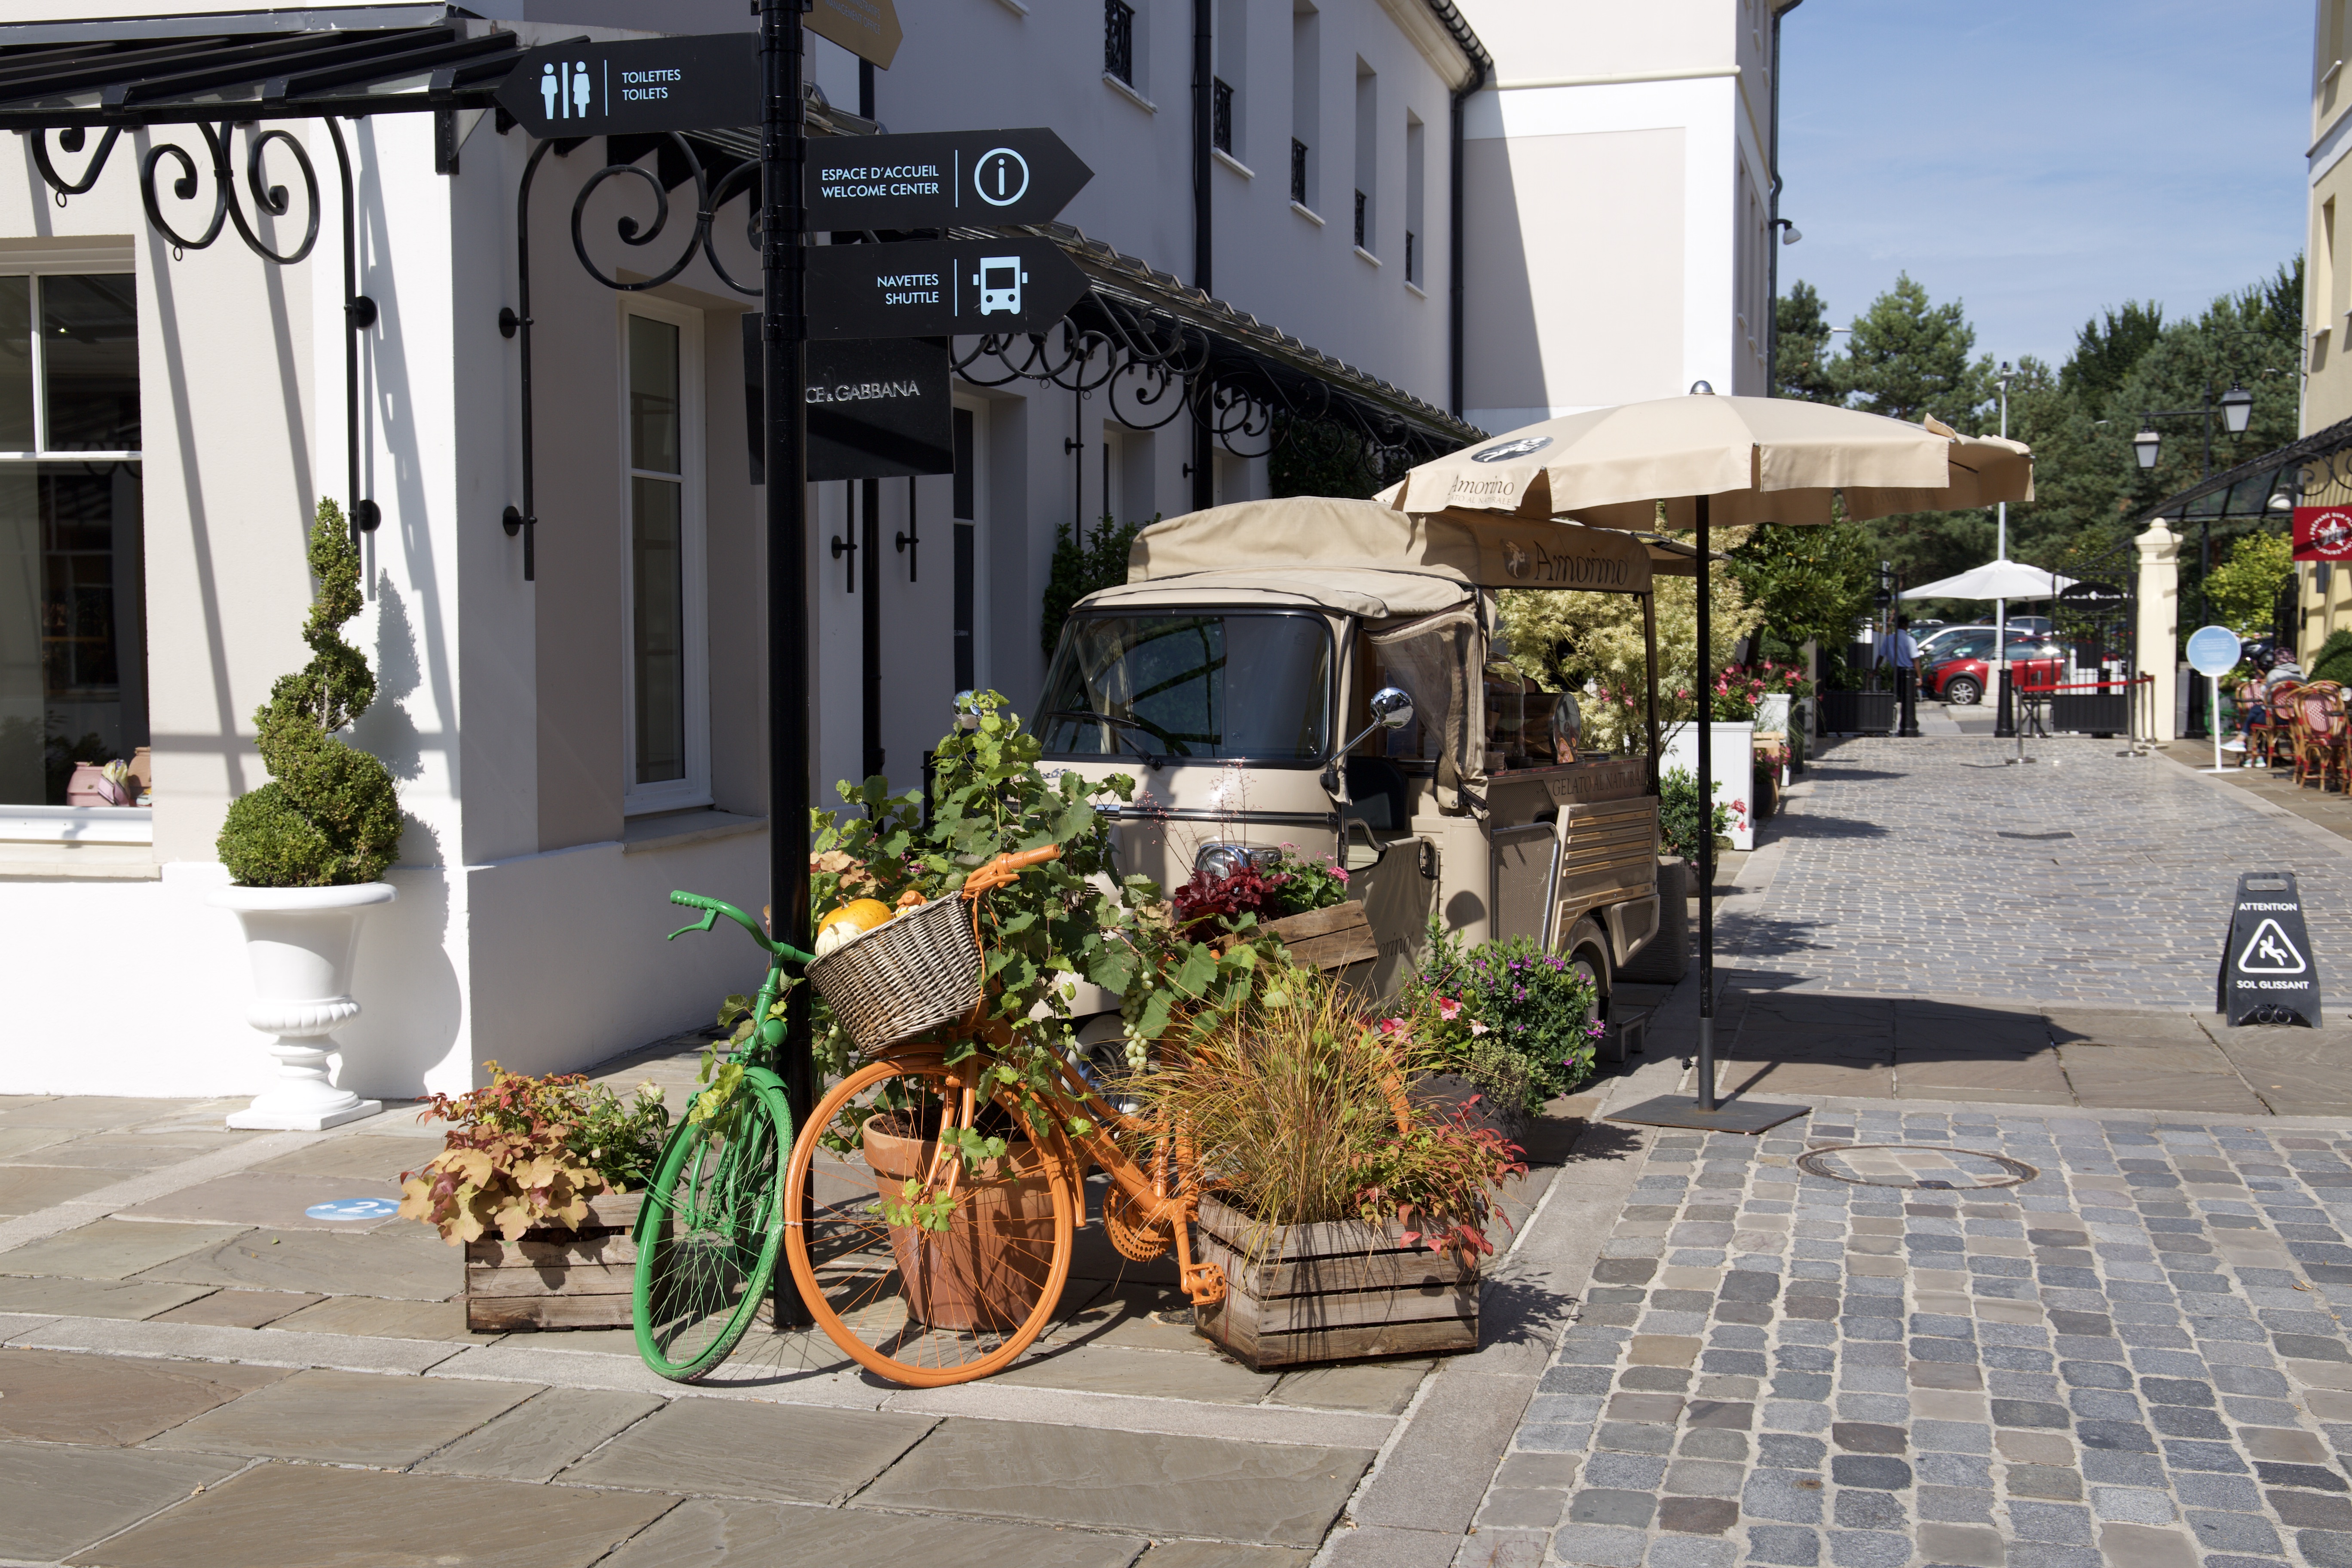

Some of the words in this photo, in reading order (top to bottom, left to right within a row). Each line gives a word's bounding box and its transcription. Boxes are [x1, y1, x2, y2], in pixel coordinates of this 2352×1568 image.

[863, 17, 880, 35] OFFICE
[622, 69, 681, 83] TOILETTES
[622, 87, 668, 101] TOILETS
[822, 168, 867, 181] ESPACE
[871, 165, 939, 178] D'ACCUEIL
[821, 184, 886, 198] WELCOME
[890, 183, 939, 195] CENTER
[877, 274, 939, 287] NAVETTES
[885, 291, 939, 305] SHUTTLE
[835, 380, 920, 401] GABBANA
[1448, 474, 1514, 495] Amorino
[1533, 540, 1628, 585] Amorino
[1553, 776, 1591, 796] GELATO
[1593, 775, 1604, 791] AL
[2239, 903, 2298, 911] ATTENTION
[1378, 932, 1411, 960] orino
[2237, 980, 2257, 989] SOL
[2259, 980, 2309, 989] GLISSANT
[337, 1202, 379, 1213] 2
